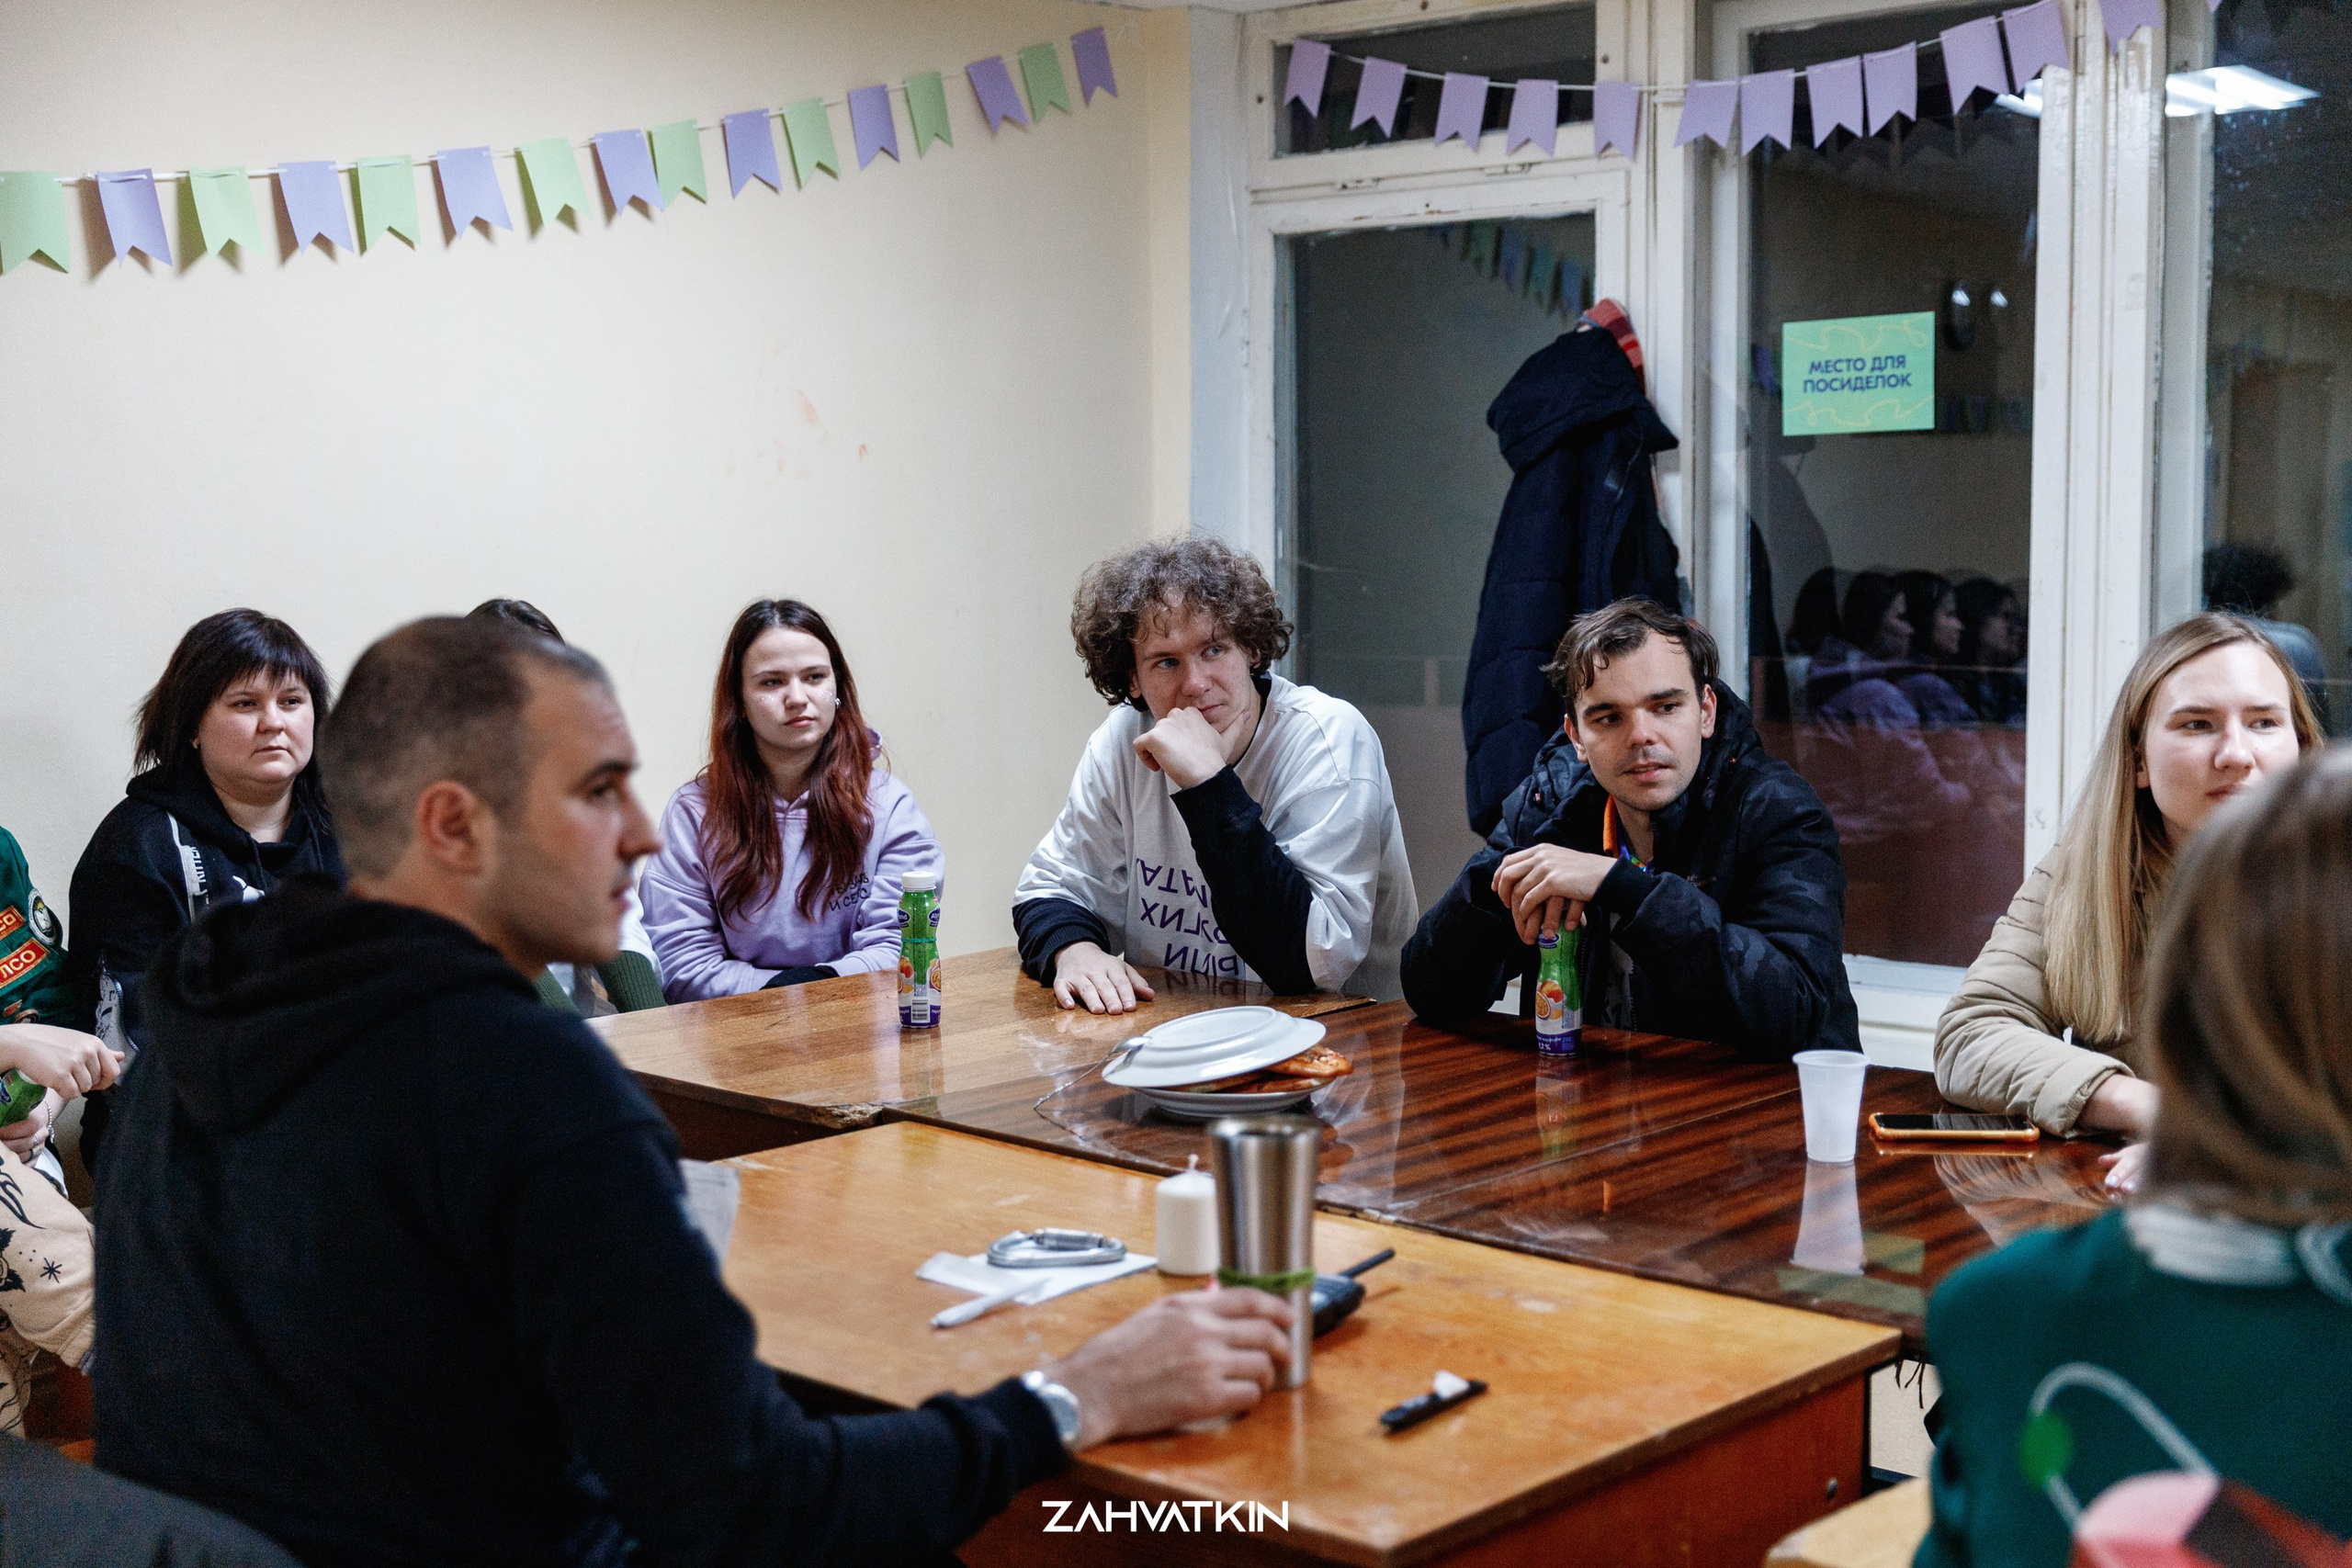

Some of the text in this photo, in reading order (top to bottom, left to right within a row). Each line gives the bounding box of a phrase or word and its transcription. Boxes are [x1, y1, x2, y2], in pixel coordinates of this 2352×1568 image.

[1808, 354, 1907, 375] МЕСТО ДЛЯ
[1803, 372, 1913, 393] ПОСИДЕЛОК
[1139, 897, 1231, 944] РУГИХ
[1163, 942, 1239, 977] ЫЛИ
